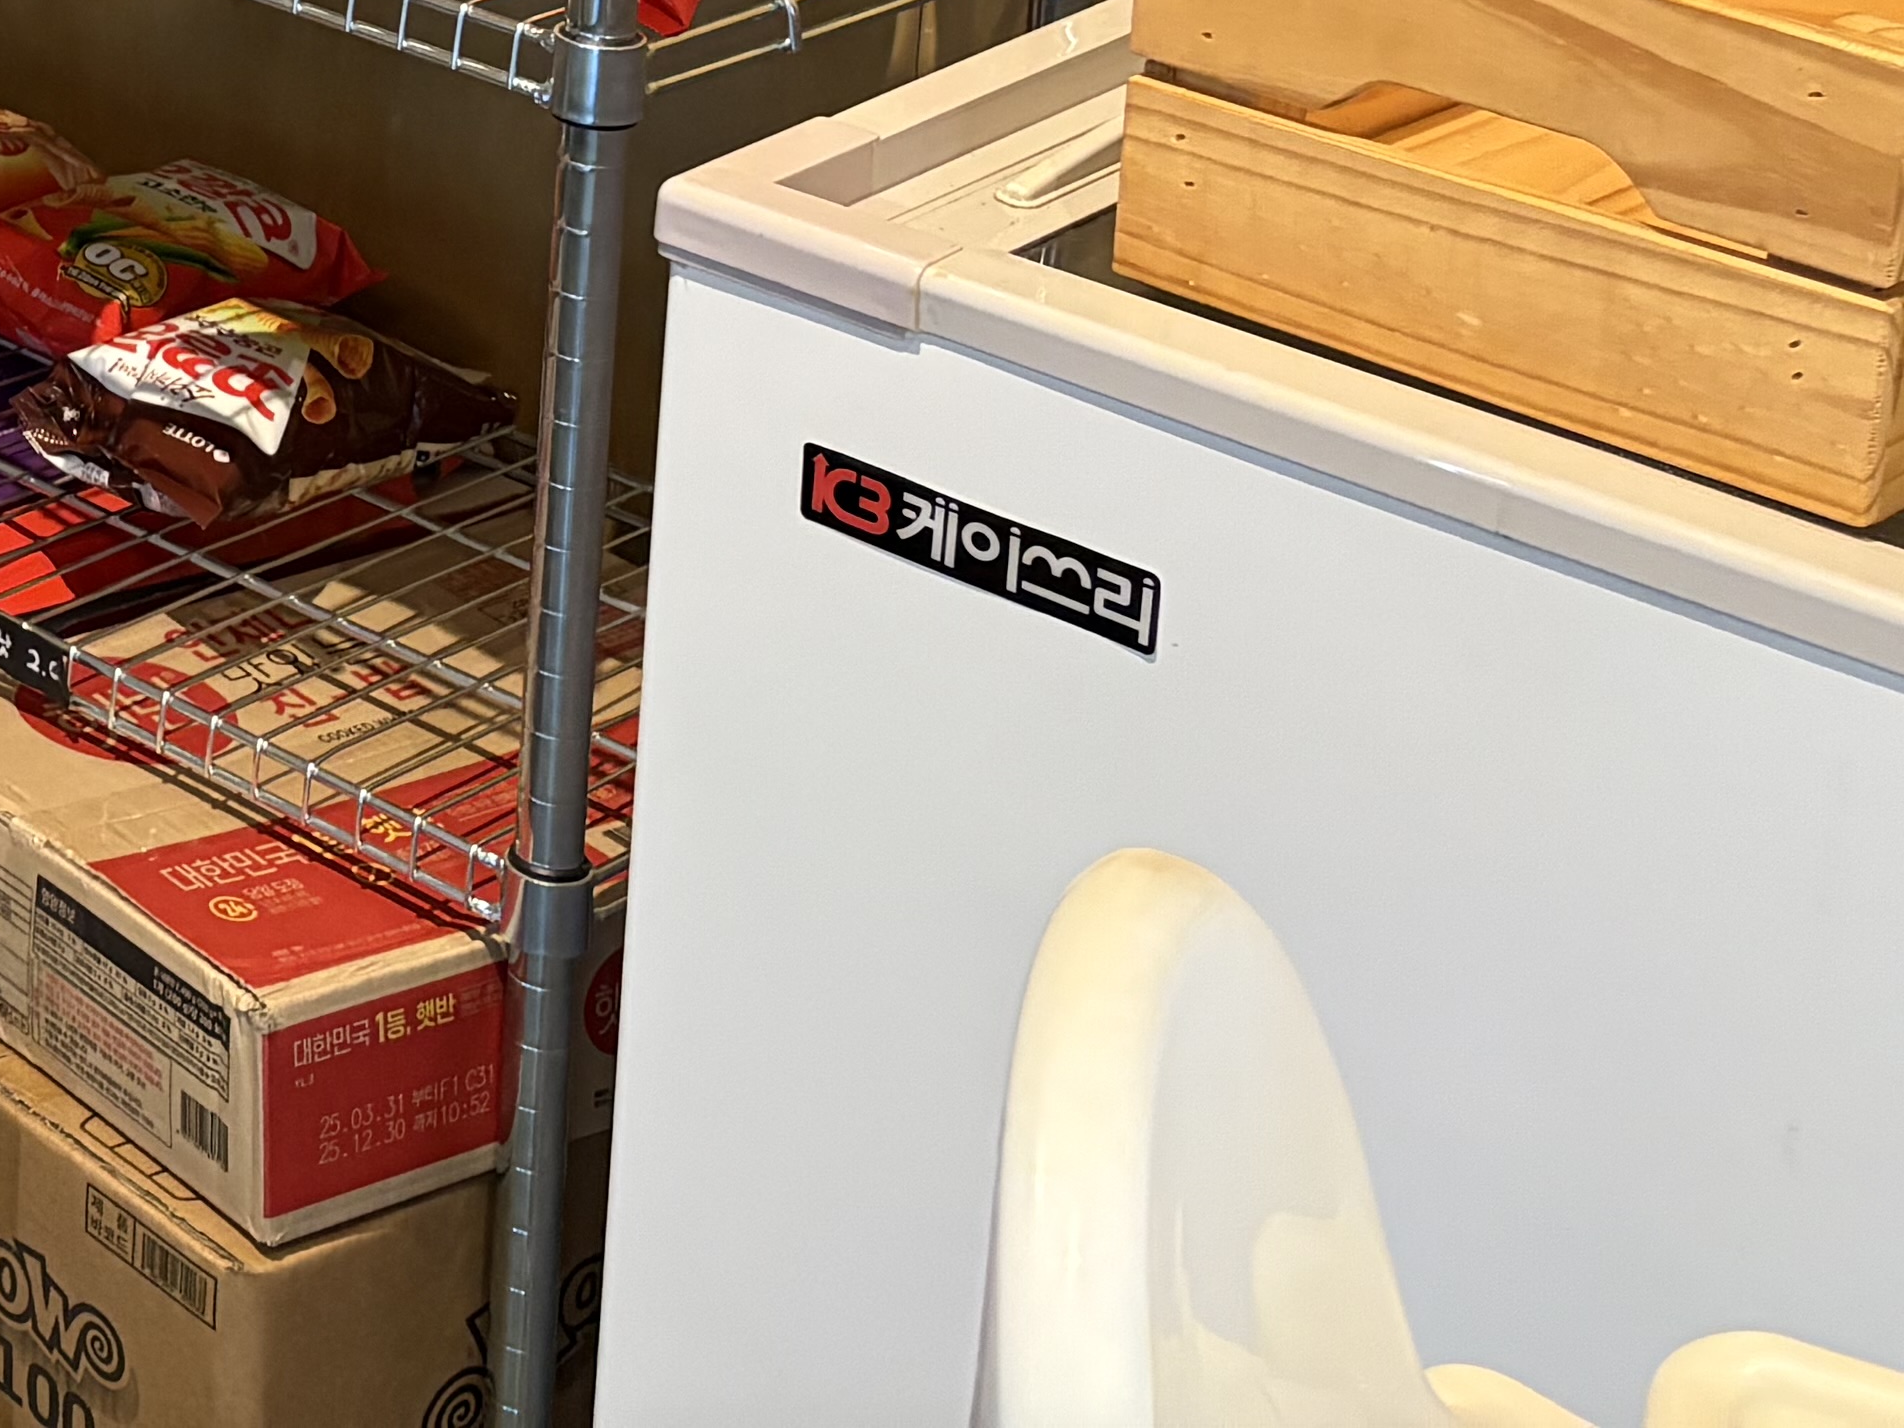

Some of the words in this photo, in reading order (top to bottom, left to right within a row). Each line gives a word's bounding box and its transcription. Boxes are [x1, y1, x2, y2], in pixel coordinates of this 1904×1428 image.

[162, 422, 216, 454] LOTTE
[896, 489, 1159, 648] 케이쓰리
[293, 1018, 371, 1068] 대한민국
[375, 1007, 412, 1043] 1등,
[416, 992, 457, 1032] 햇반
[319, 1093, 405, 1139] 25.03.31
[318, 1118, 407, 1166] 25.12.30
